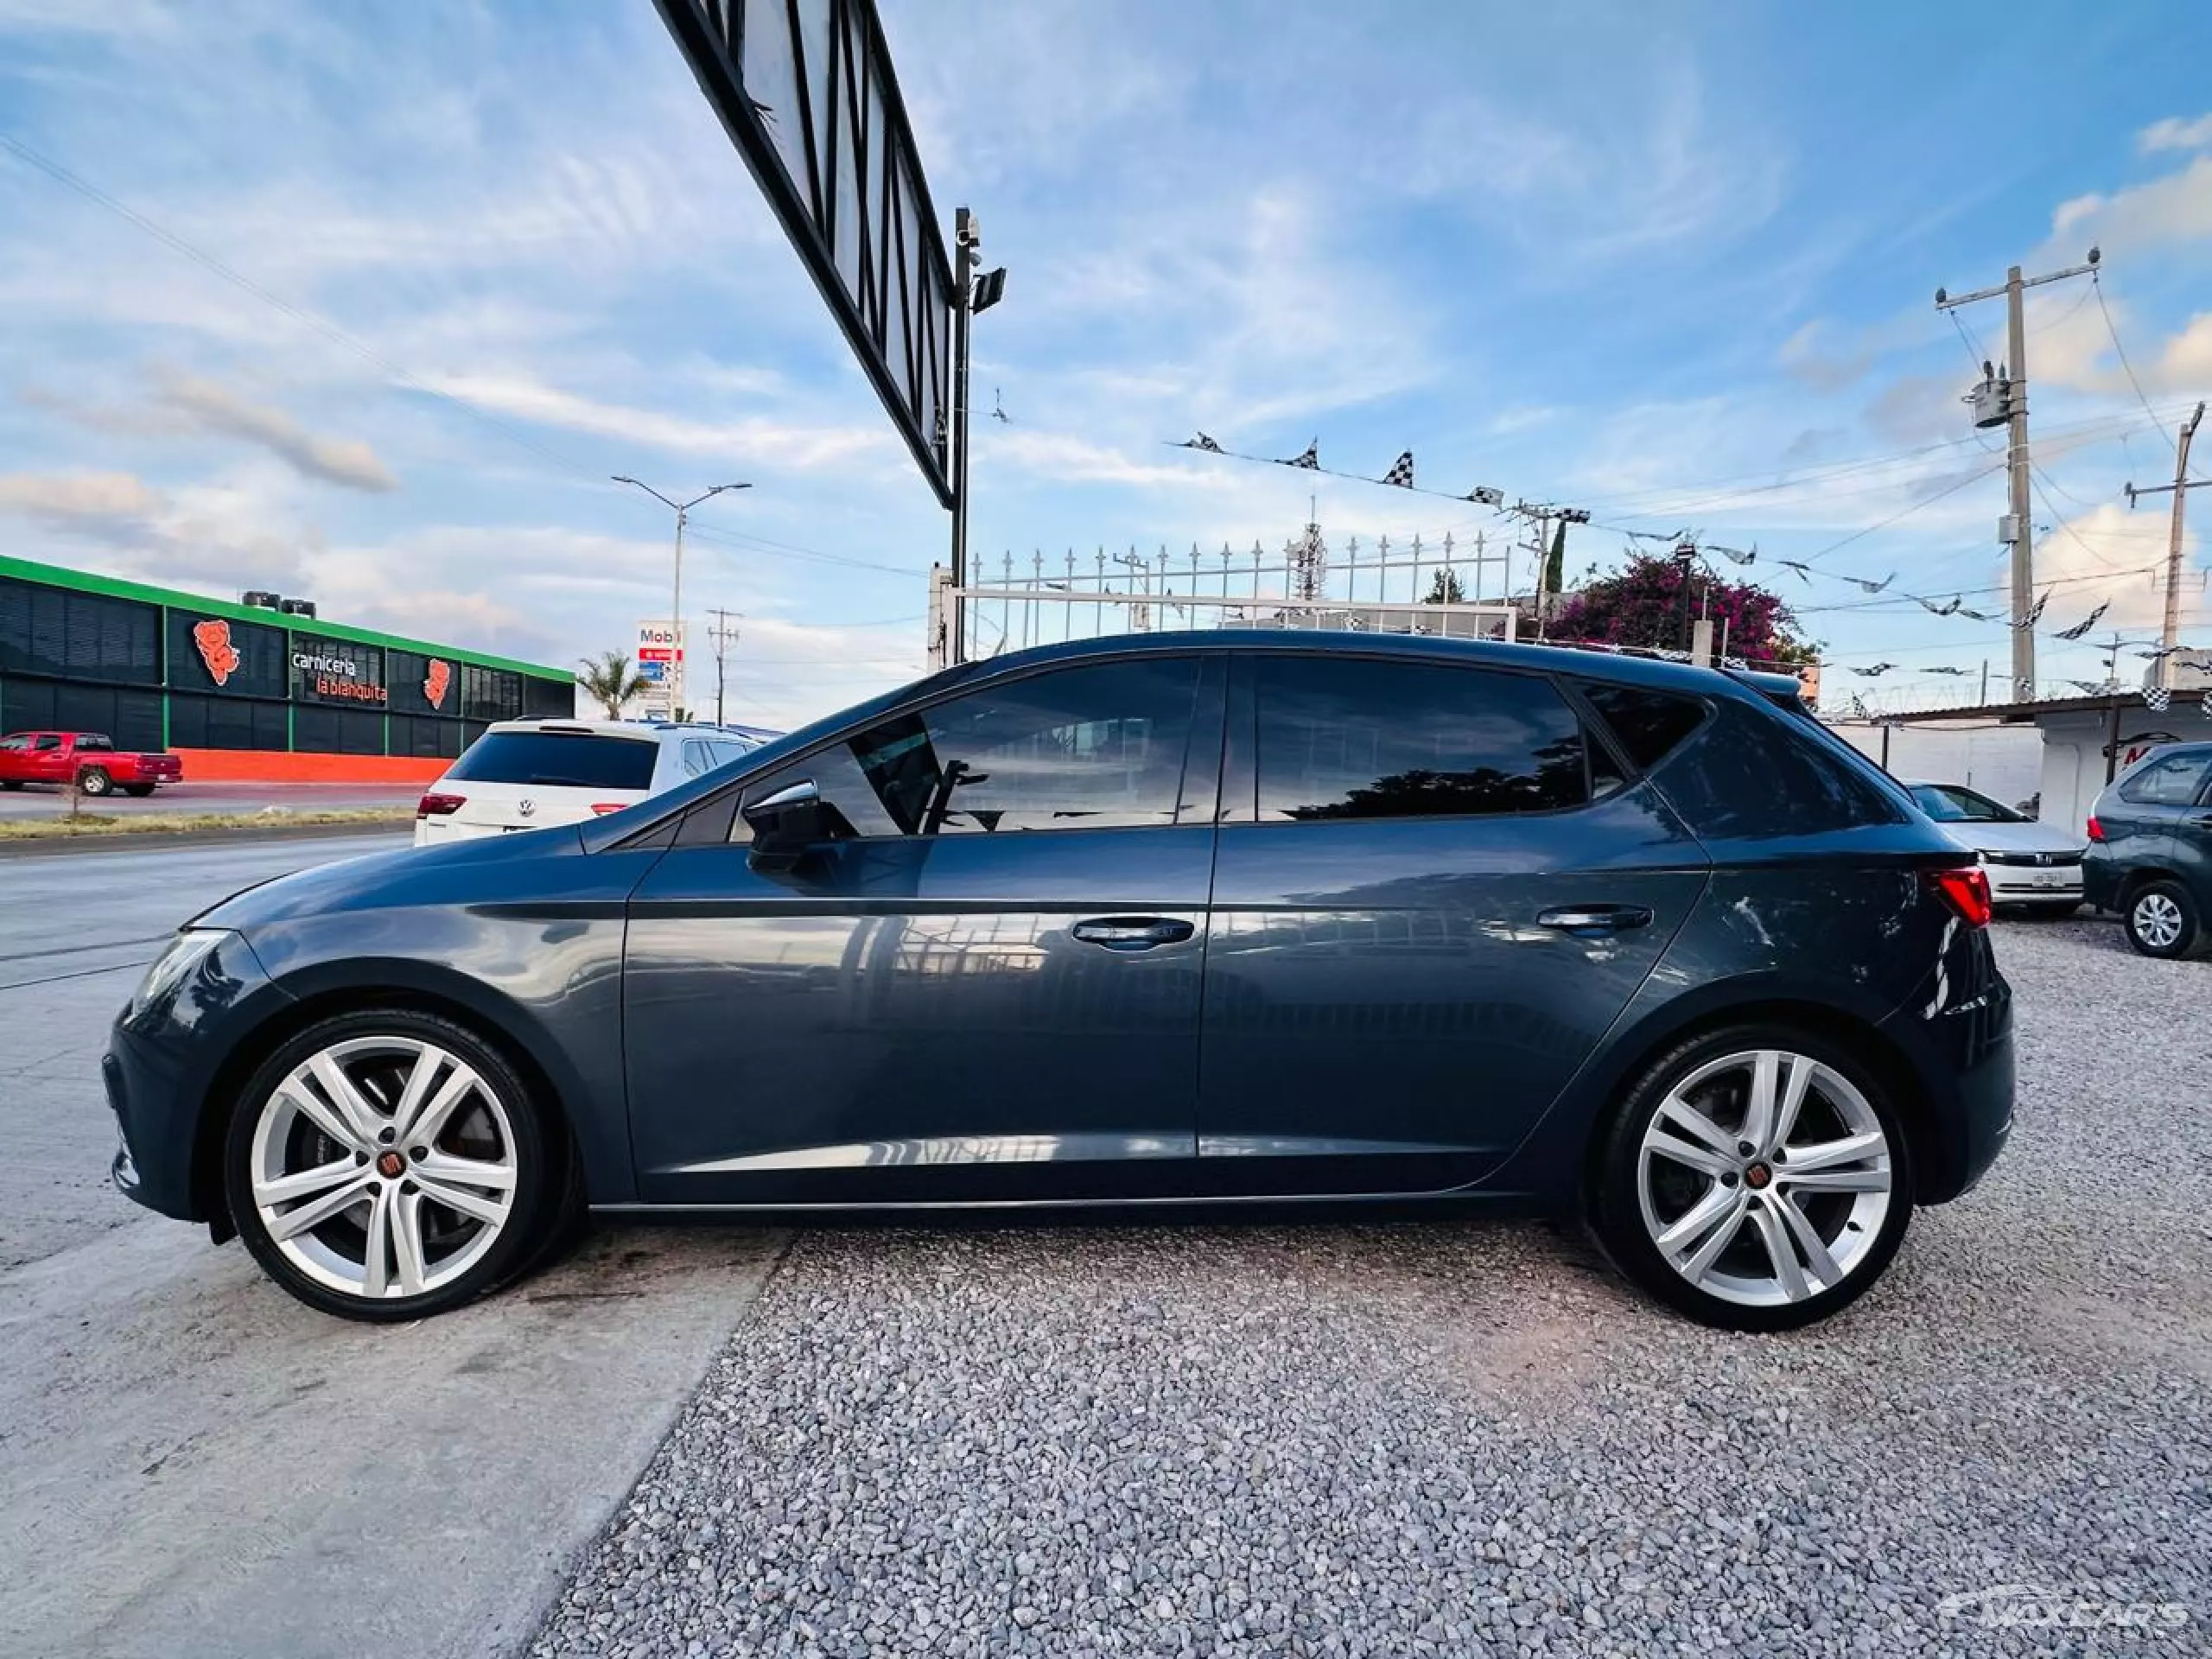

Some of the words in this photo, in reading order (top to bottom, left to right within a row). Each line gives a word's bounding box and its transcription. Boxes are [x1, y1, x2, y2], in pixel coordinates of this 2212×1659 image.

[640, 629, 682, 643] Mobl
[317, 676, 327, 694] la
[329, 680, 387, 700] blanquita
